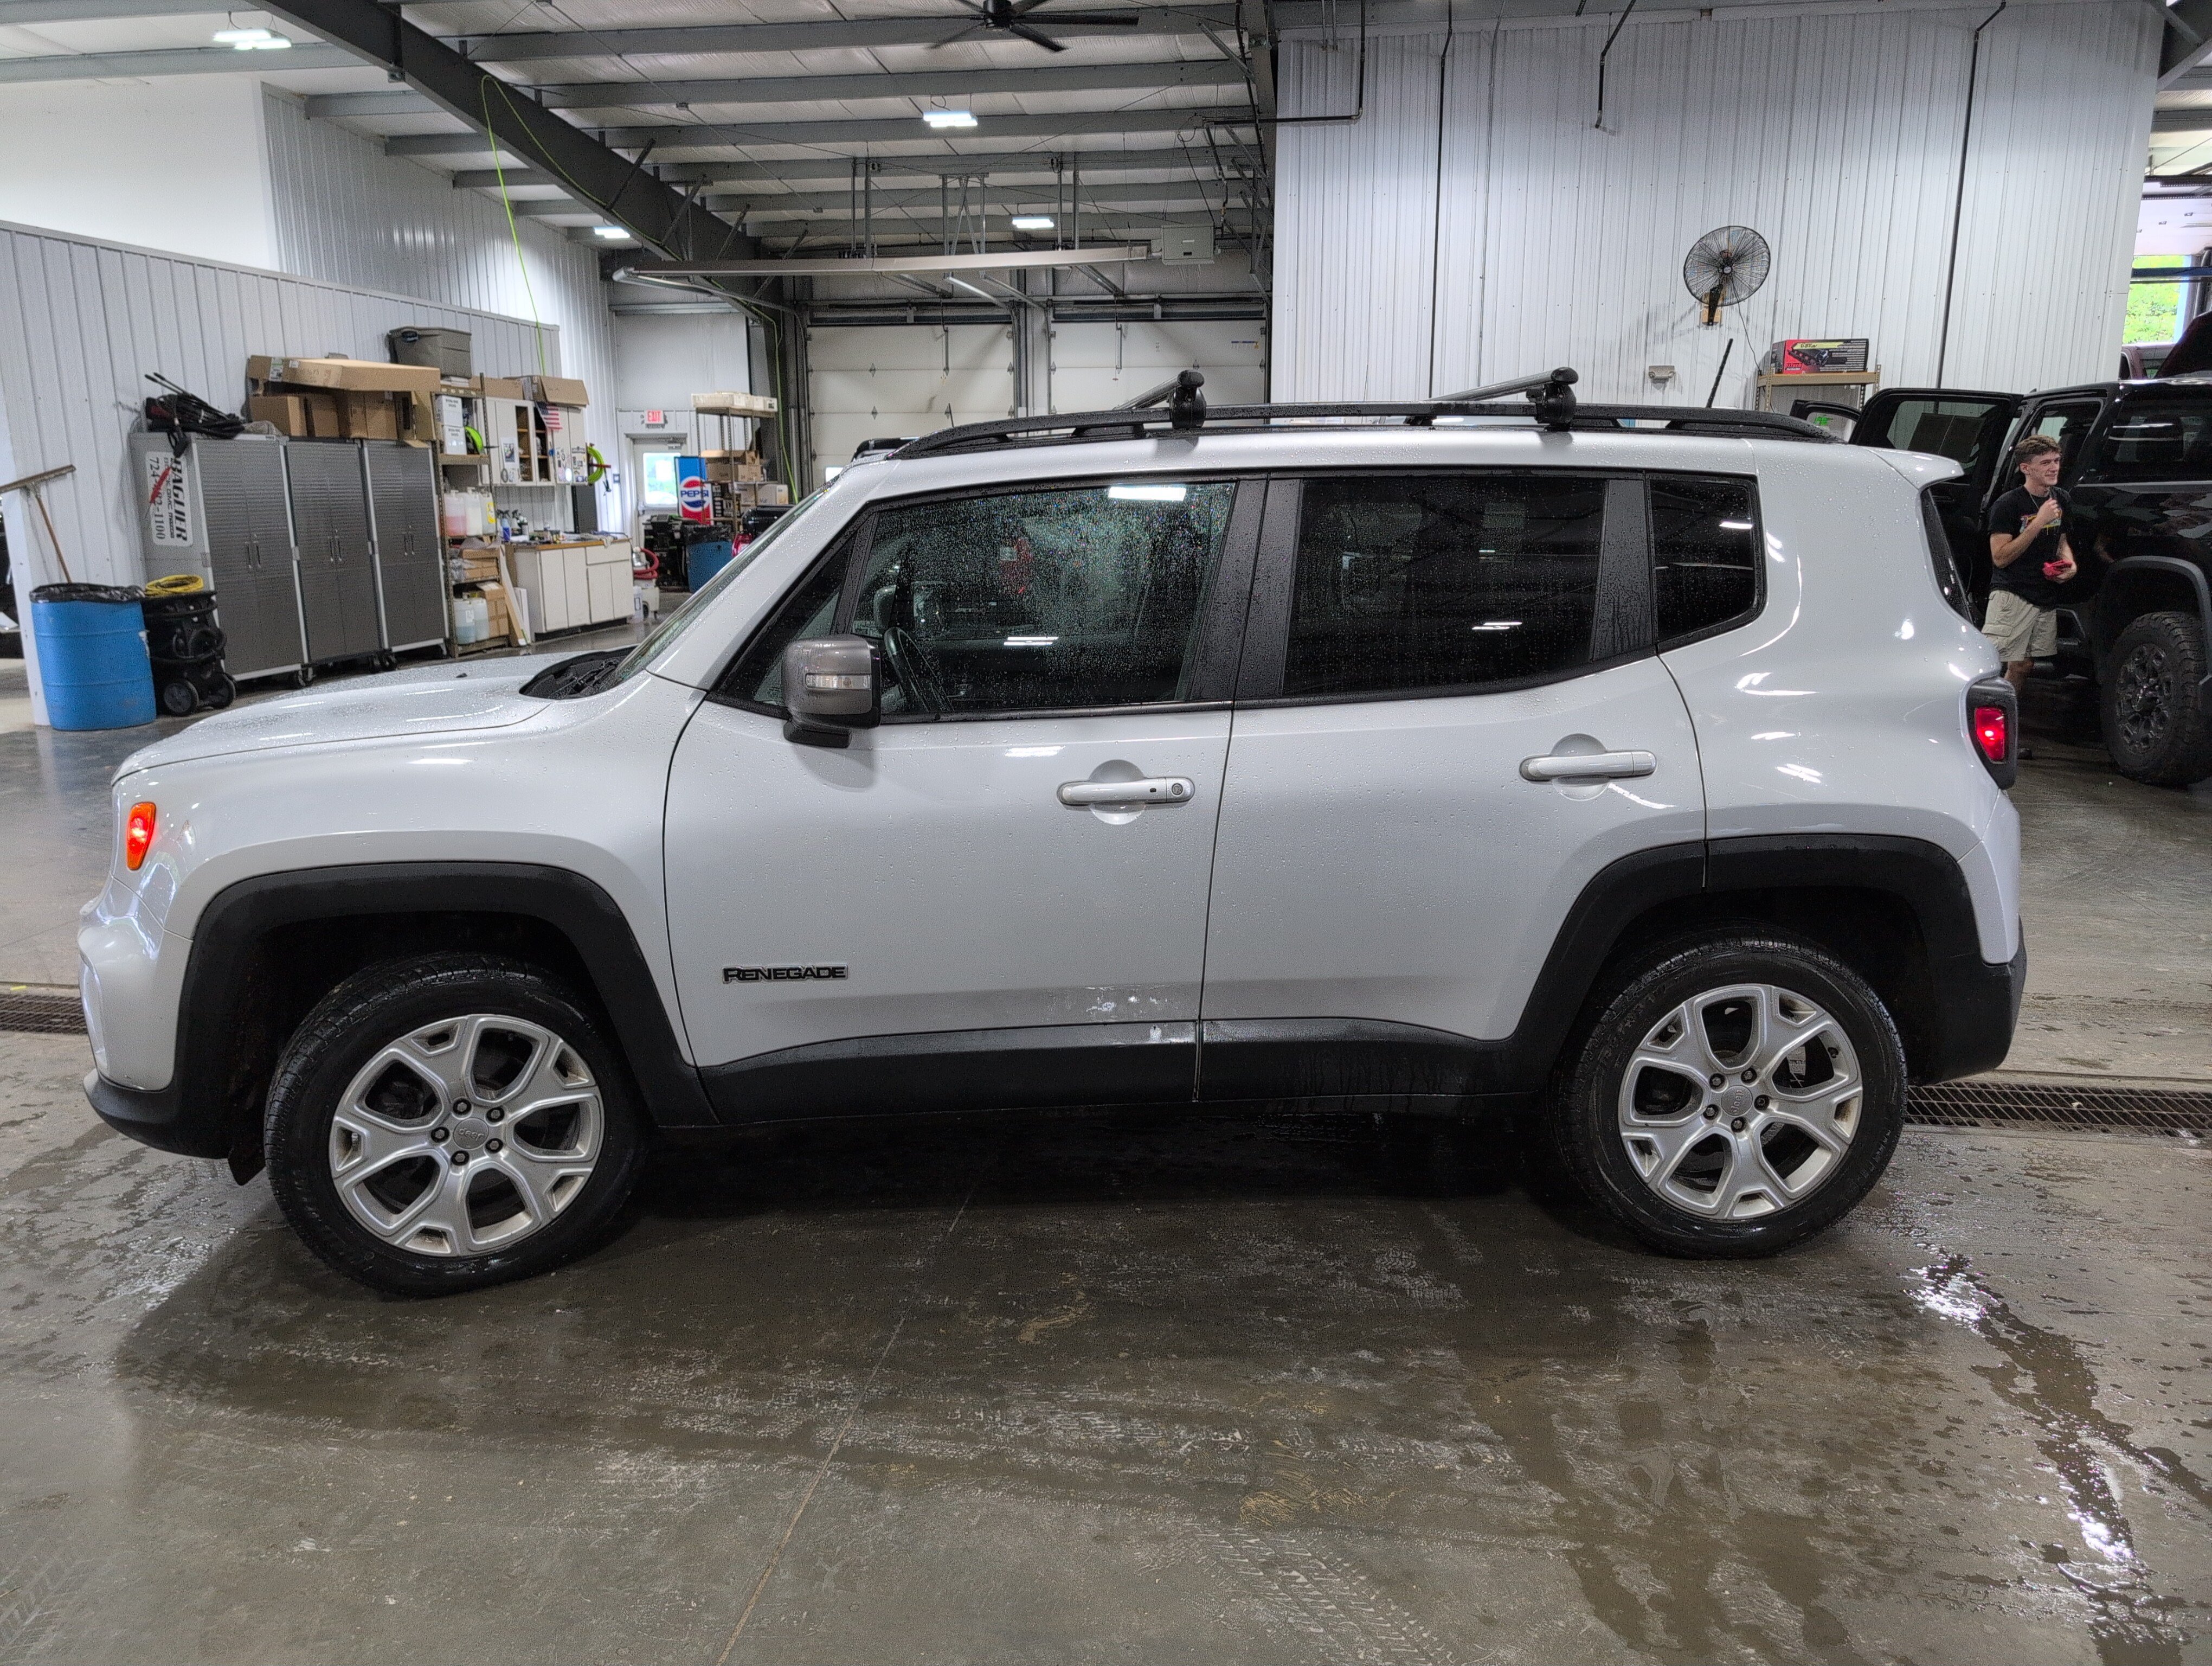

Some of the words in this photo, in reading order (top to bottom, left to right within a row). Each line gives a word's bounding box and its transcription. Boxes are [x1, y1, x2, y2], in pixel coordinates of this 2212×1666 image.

[647, 411, 661, 422] EXIT
[150, 457, 165, 540] 724-82-1100
[171, 457, 188, 541] BAGLIER
[680, 490, 709, 498] PEPSI
[723, 964, 847, 983] RENEGADE
[458, 1127, 484, 1141] Jeep
